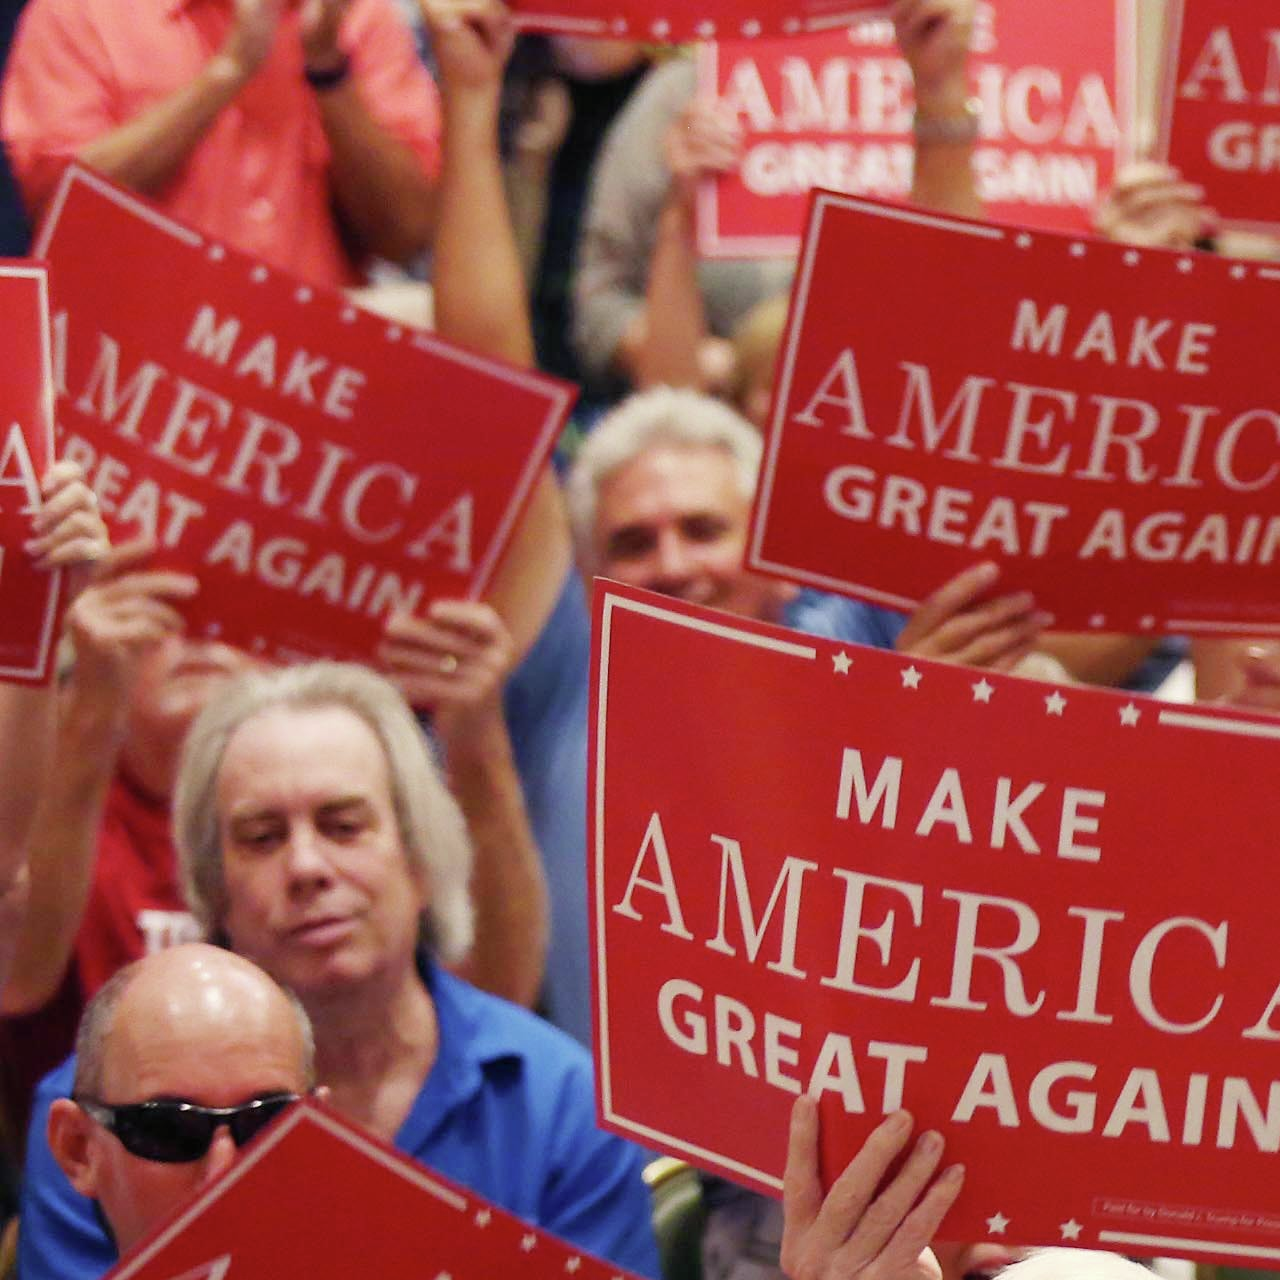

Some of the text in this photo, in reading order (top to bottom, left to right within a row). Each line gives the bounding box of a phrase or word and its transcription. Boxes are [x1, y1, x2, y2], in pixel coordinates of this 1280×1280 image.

[723, 56, 1119, 149] AMEICA
[184, 305, 367, 420] MAKE
[1010, 299, 1216, 375] MAKE
[58, 428, 206, 549] REAT
[205, 519, 424, 616] AGAIN
[824, 464, 1068, 559] GREAT
[835, 747, 1106, 863] MAKE
[656, 978, 929, 1114] GREAT
